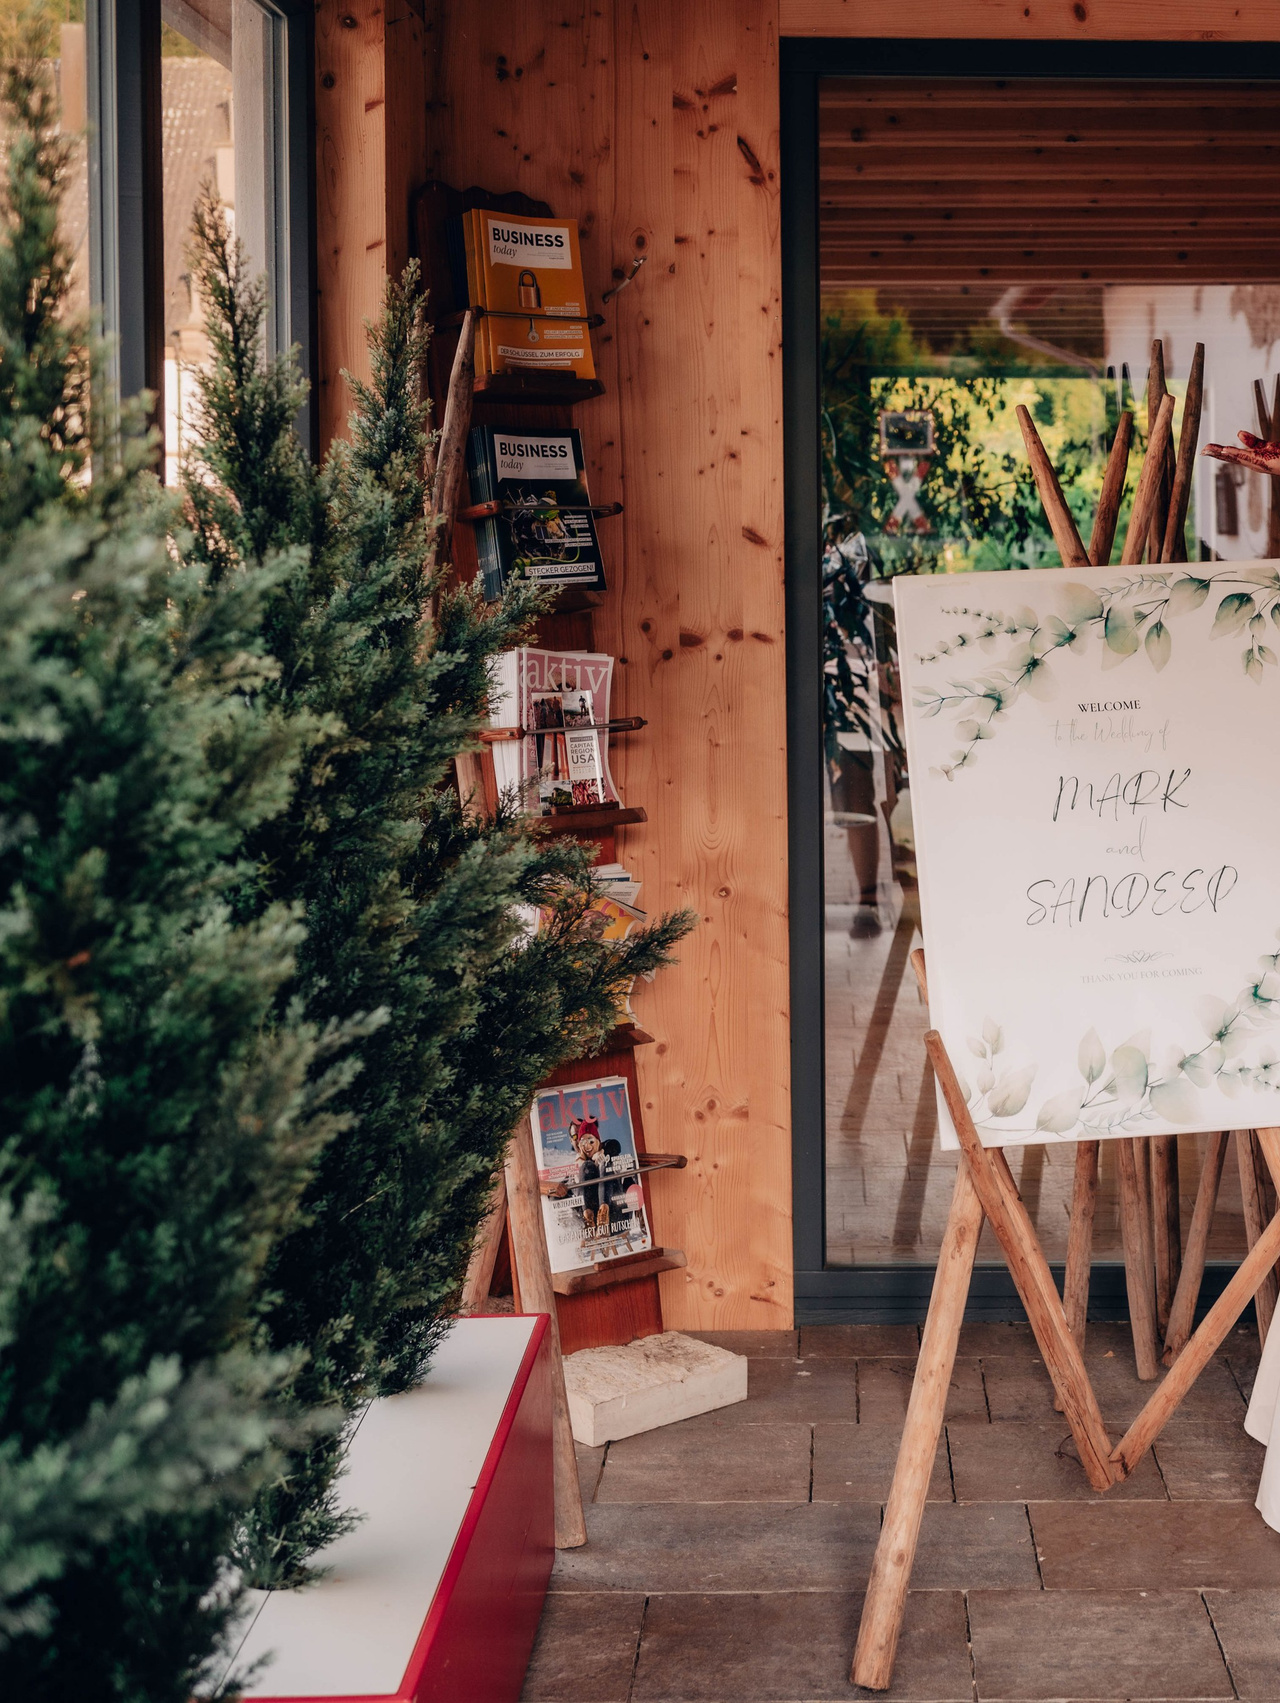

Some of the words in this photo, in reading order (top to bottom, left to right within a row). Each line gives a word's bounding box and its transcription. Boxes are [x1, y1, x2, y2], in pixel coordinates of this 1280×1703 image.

[492, 227, 564, 248] BUSINESS
[493, 245, 517, 259] today
[500, 347, 510, 355] DER
[510, 348, 538, 358] SCHLÜSSEL
[540, 350, 554, 358] ZUM
[499, 442, 568, 458] BUSINESS
[500, 459, 524, 472] today
[528, 566, 559, 575] STECKER
[526, 656, 609, 694] aktiv
[1077, 699, 1141, 713] WELCOME
[1048, 718, 1062, 748] to
[1062, 717, 1088, 747] the
[1094, 715, 1155, 753] Wedding
[1158, 719, 1171, 751] of
[571, 753, 595, 764] USA
[1052, 767, 1192, 823] MARK
[1105, 815, 1148, 862] and
[1025, 865, 1239, 928] SANDEEP
[1081, 973, 1115, 984] THANK
[1117, 971, 1138, 981] YOU
[1140, 970, 1160, 979] FOR
[1162, 967, 1203, 978] COMING
[538, 1084, 626, 1132] aktiv
[597, 1223, 610, 1236] GUT
